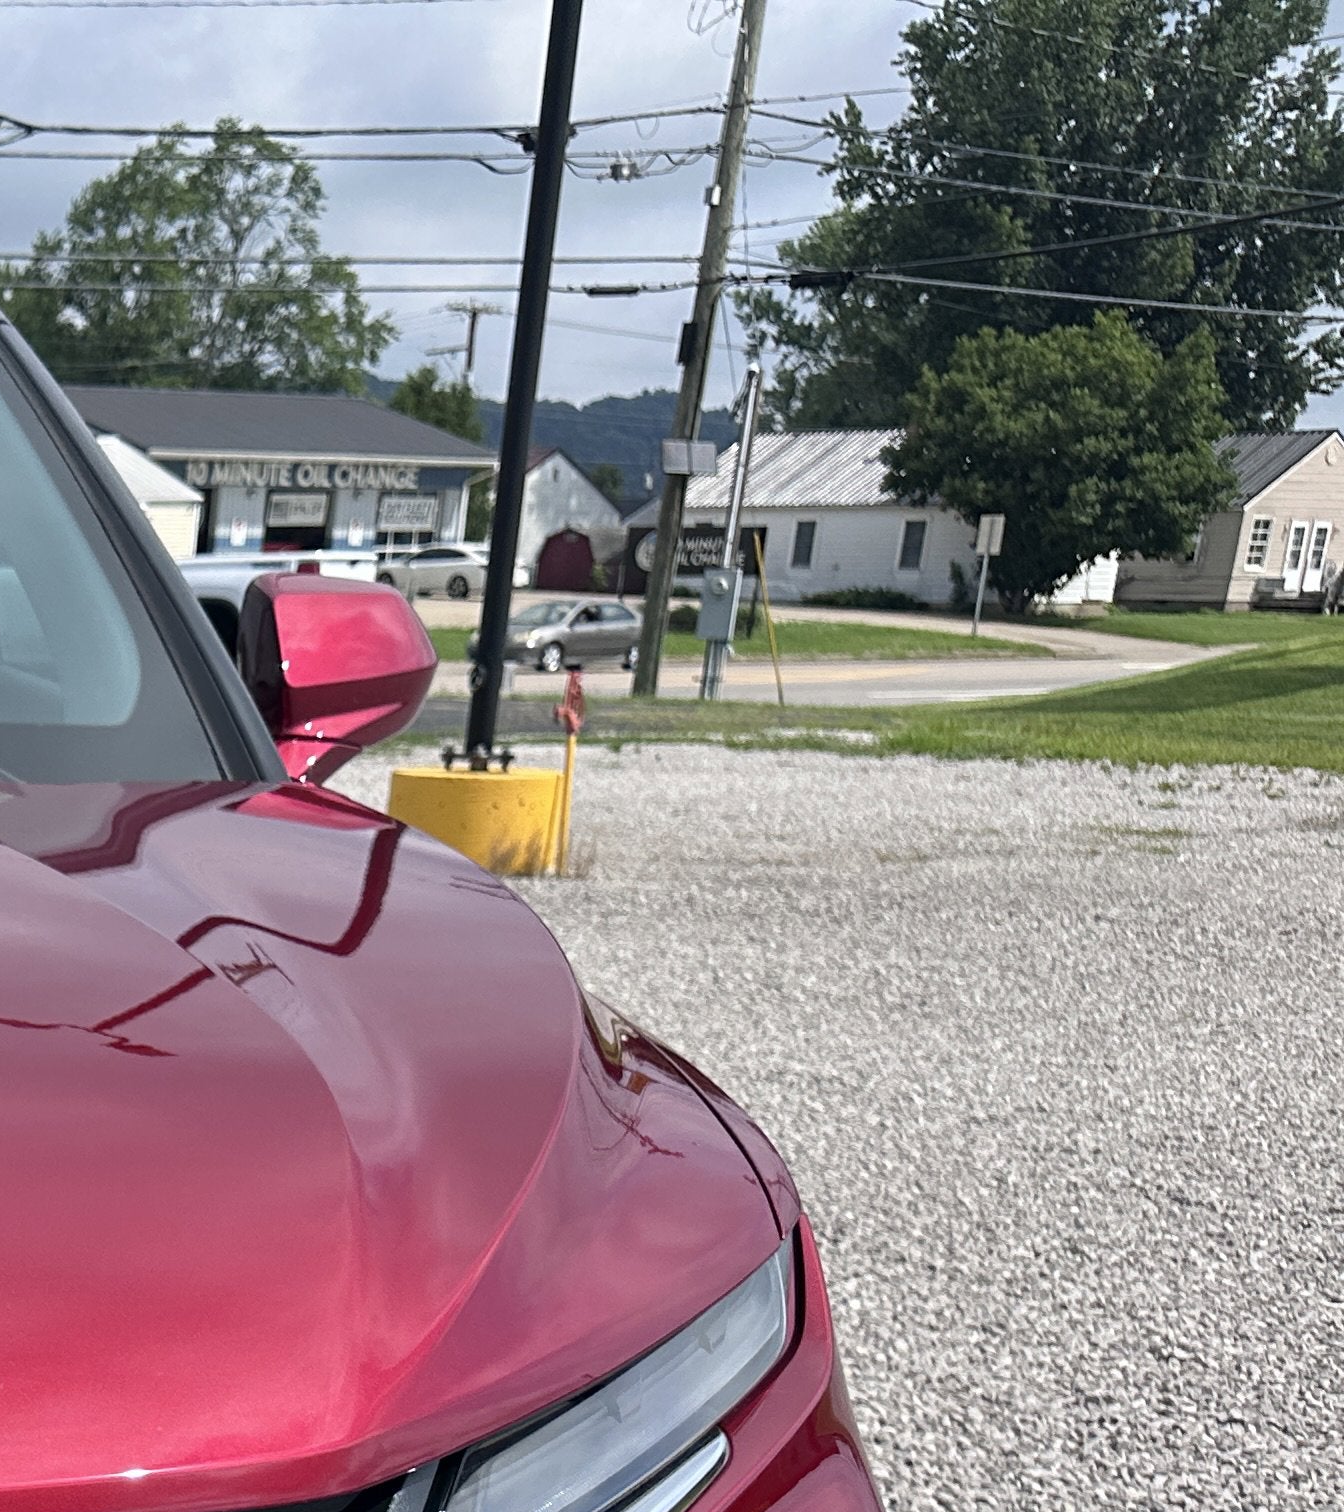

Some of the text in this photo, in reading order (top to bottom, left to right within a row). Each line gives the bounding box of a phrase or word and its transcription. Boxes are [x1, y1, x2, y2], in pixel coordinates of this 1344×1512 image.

[211, 462, 293, 488] MINUTE
[296, 462, 331, 489] OIL
[334, 463, 418, 490] CHANGE
